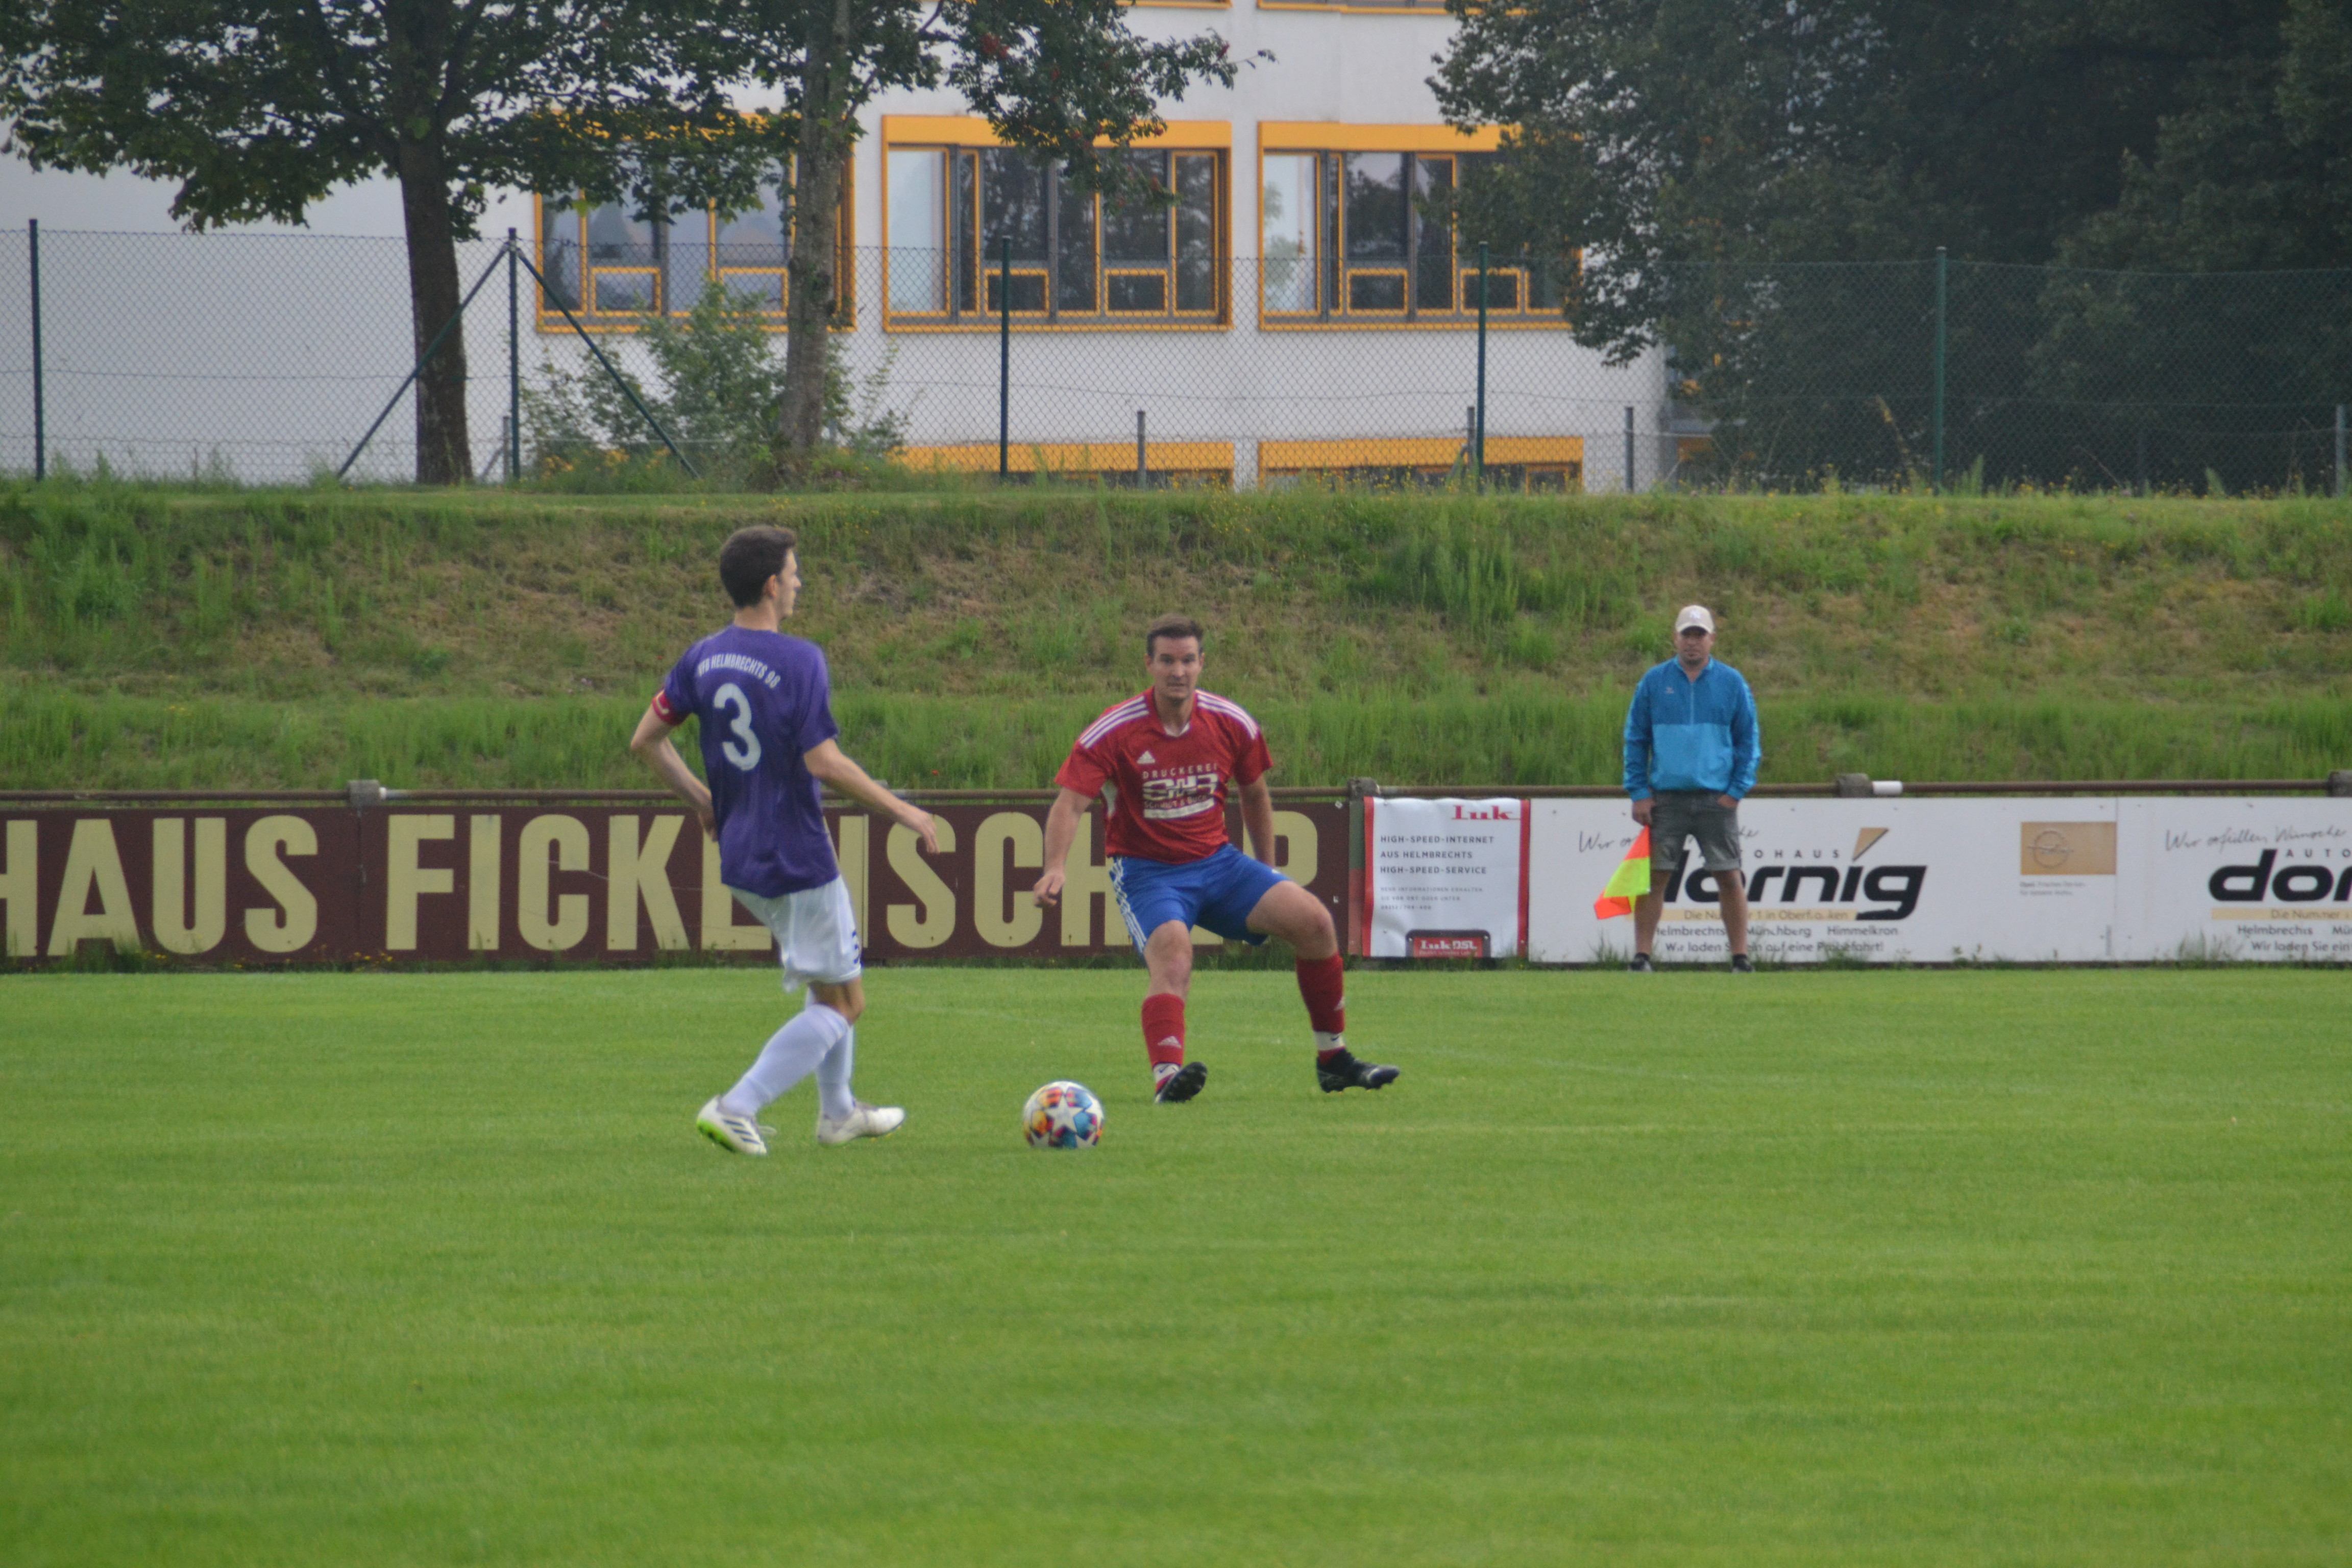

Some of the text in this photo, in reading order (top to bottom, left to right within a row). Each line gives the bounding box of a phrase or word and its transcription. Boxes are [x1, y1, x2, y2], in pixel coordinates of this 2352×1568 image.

[711, 652, 768, 680] HELMBRECHTS
[765, 670, 781, 689] 98
[714, 682, 762, 771] 3
[1142, 763, 1218, 779] DRUCKEREI
[1380, 835, 1494, 843] HIGH-SPEED-INTERNET
[1403, 851, 1473, 859] HELMBRECHTS
[1740, 849, 1840, 858] OHAUS
[2286, 849, 2351, 858] AUTO
[1380, 866, 1487, 874] HIGH-SPEED-SERVICE
[1657, 926, 1725, 936] elmbrechts
[1827, 925, 1899, 936] Himmelkron
[2237, 924, 2352, 935] Helmbrechts Mü
[1452, 940, 1478, 950] DSL
[1688, 942, 1722, 952] laden
[1788, 943, 1813, 952] eine
[2251, 941, 2271, 951] Wir
[2275, 940, 2309, 951] laden
[2312, 941, 2329, 951] Sie
